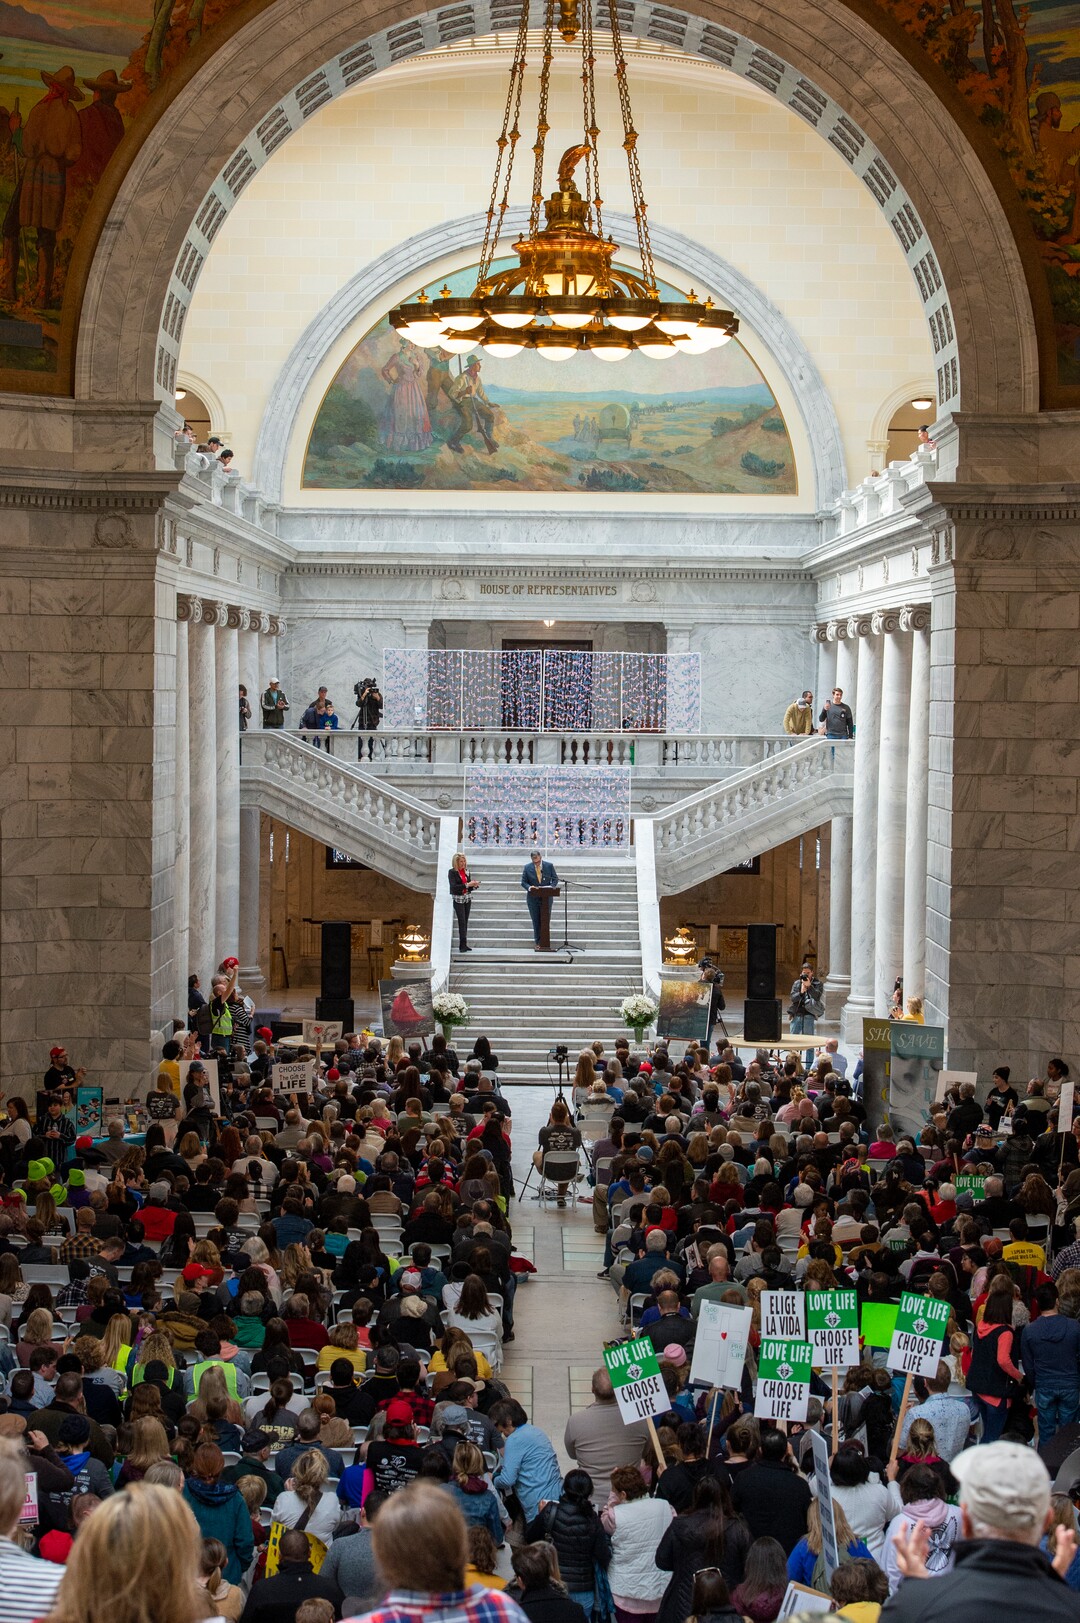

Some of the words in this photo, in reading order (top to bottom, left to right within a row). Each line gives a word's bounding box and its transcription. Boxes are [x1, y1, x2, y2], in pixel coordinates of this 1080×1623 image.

[480, 584, 511, 595] HOUSE
[512, 584, 525, 595] OF
[527, 585, 618, 596] REPRESENTATIVES
[866, 1028, 891, 1042] SH
[897, 1033, 938, 1050] SAVE
[279, 1065, 306, 1073] CHOOSE
[280, 1079, 306, 1089] LIFE
[956, 1177, 970, 1188] LOVE
[972, 1177, 985, 1188] LIFE
[769, 1295, 796, 1315] ELIGE
[809, 1293, 832, 1311] LOVE
[836, 1292, 855, 1310] LIFE
[901, 1295, 926, 1316] LOVE
[926, 1300, 949, 1322] LIFE
[766, 1316, 777, 1335] LA
[780, 1316, 801, 1336] VIDA
[814, 1330, 853, 1347] CHOOSE
[897, 1333, 937, 1357] CHOOSE
[605, 1348, 631, 1370] LOVE
[632, 1339, 653, 1361] LIFE
[762, 1342, 787, 1361] LOVE
[790, 1345, 811, 1364] LIFE
[824, 1348, 844, 1365] LIFE
[902, 1354, 923, 1373] LIFE
[620, 1376, 660, 1403] CHOOSE
[763, 1380, 804, 1400] CHOOSE
[635, 1397, 657, 1418] LIFE
[771, 1401, 792, 1418] LIFE
